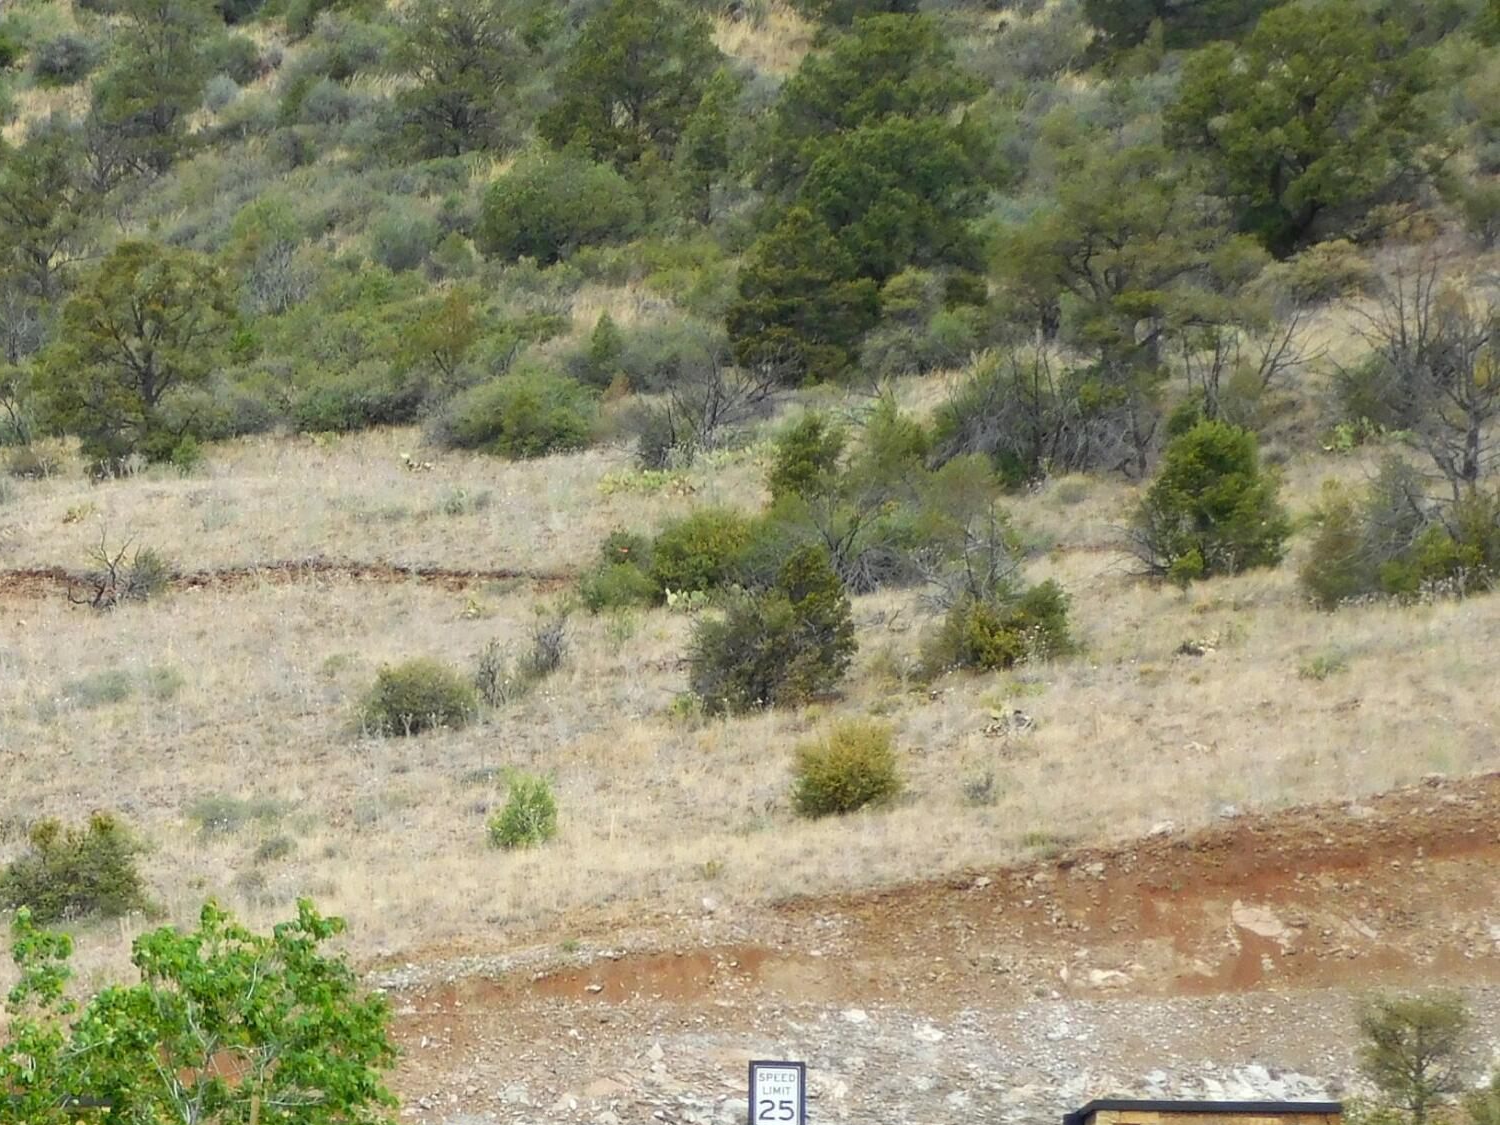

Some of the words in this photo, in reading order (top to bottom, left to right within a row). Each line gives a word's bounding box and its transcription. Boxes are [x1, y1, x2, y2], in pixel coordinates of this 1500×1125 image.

[758, 1073, 796, 1083] SPEED
[762, 1086, 791, 1096] LIMIT
[758, 1099, 795, 1121] 25
